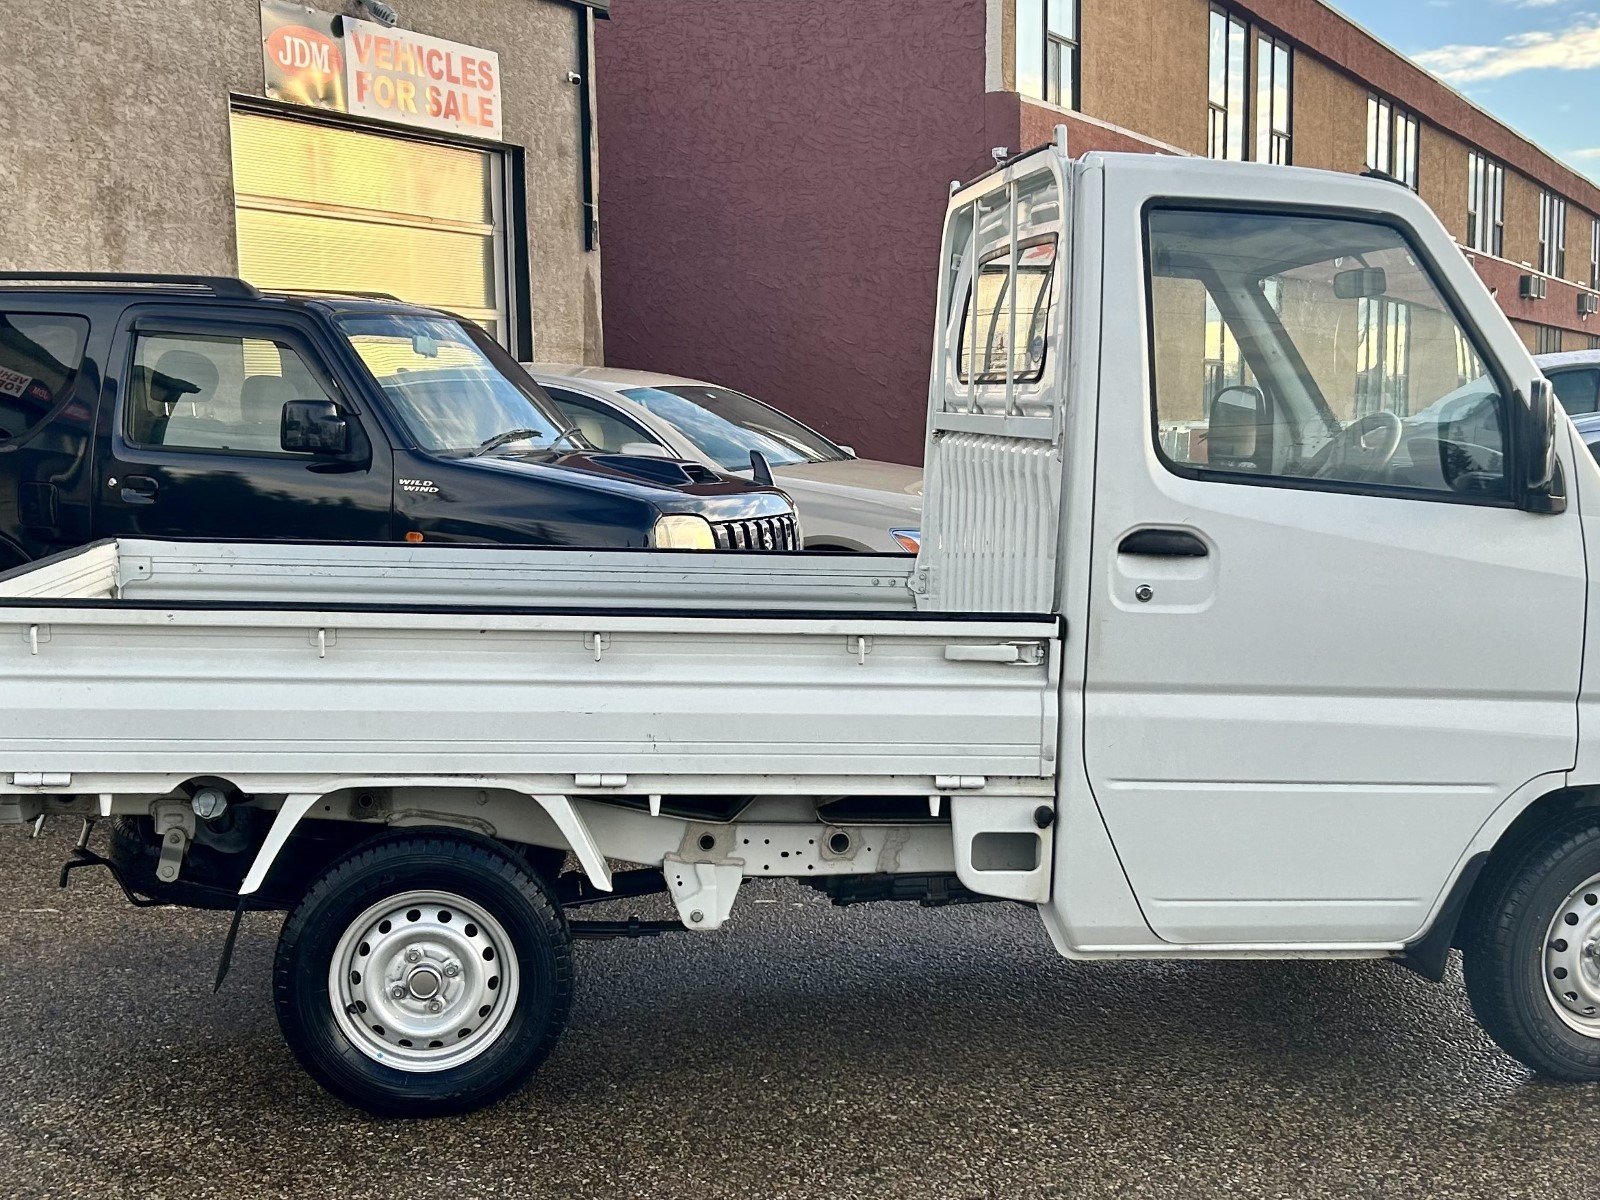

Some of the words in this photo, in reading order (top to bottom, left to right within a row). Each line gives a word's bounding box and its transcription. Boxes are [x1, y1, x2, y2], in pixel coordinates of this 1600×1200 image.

[279, 35, 330, 73] JDM
[352, 32, 494, 91] VEHICLES
[356, 70, 418, 115] FOR
[425, 85, 494, 128] SALE
[404, 485, 439, 493] WIND
